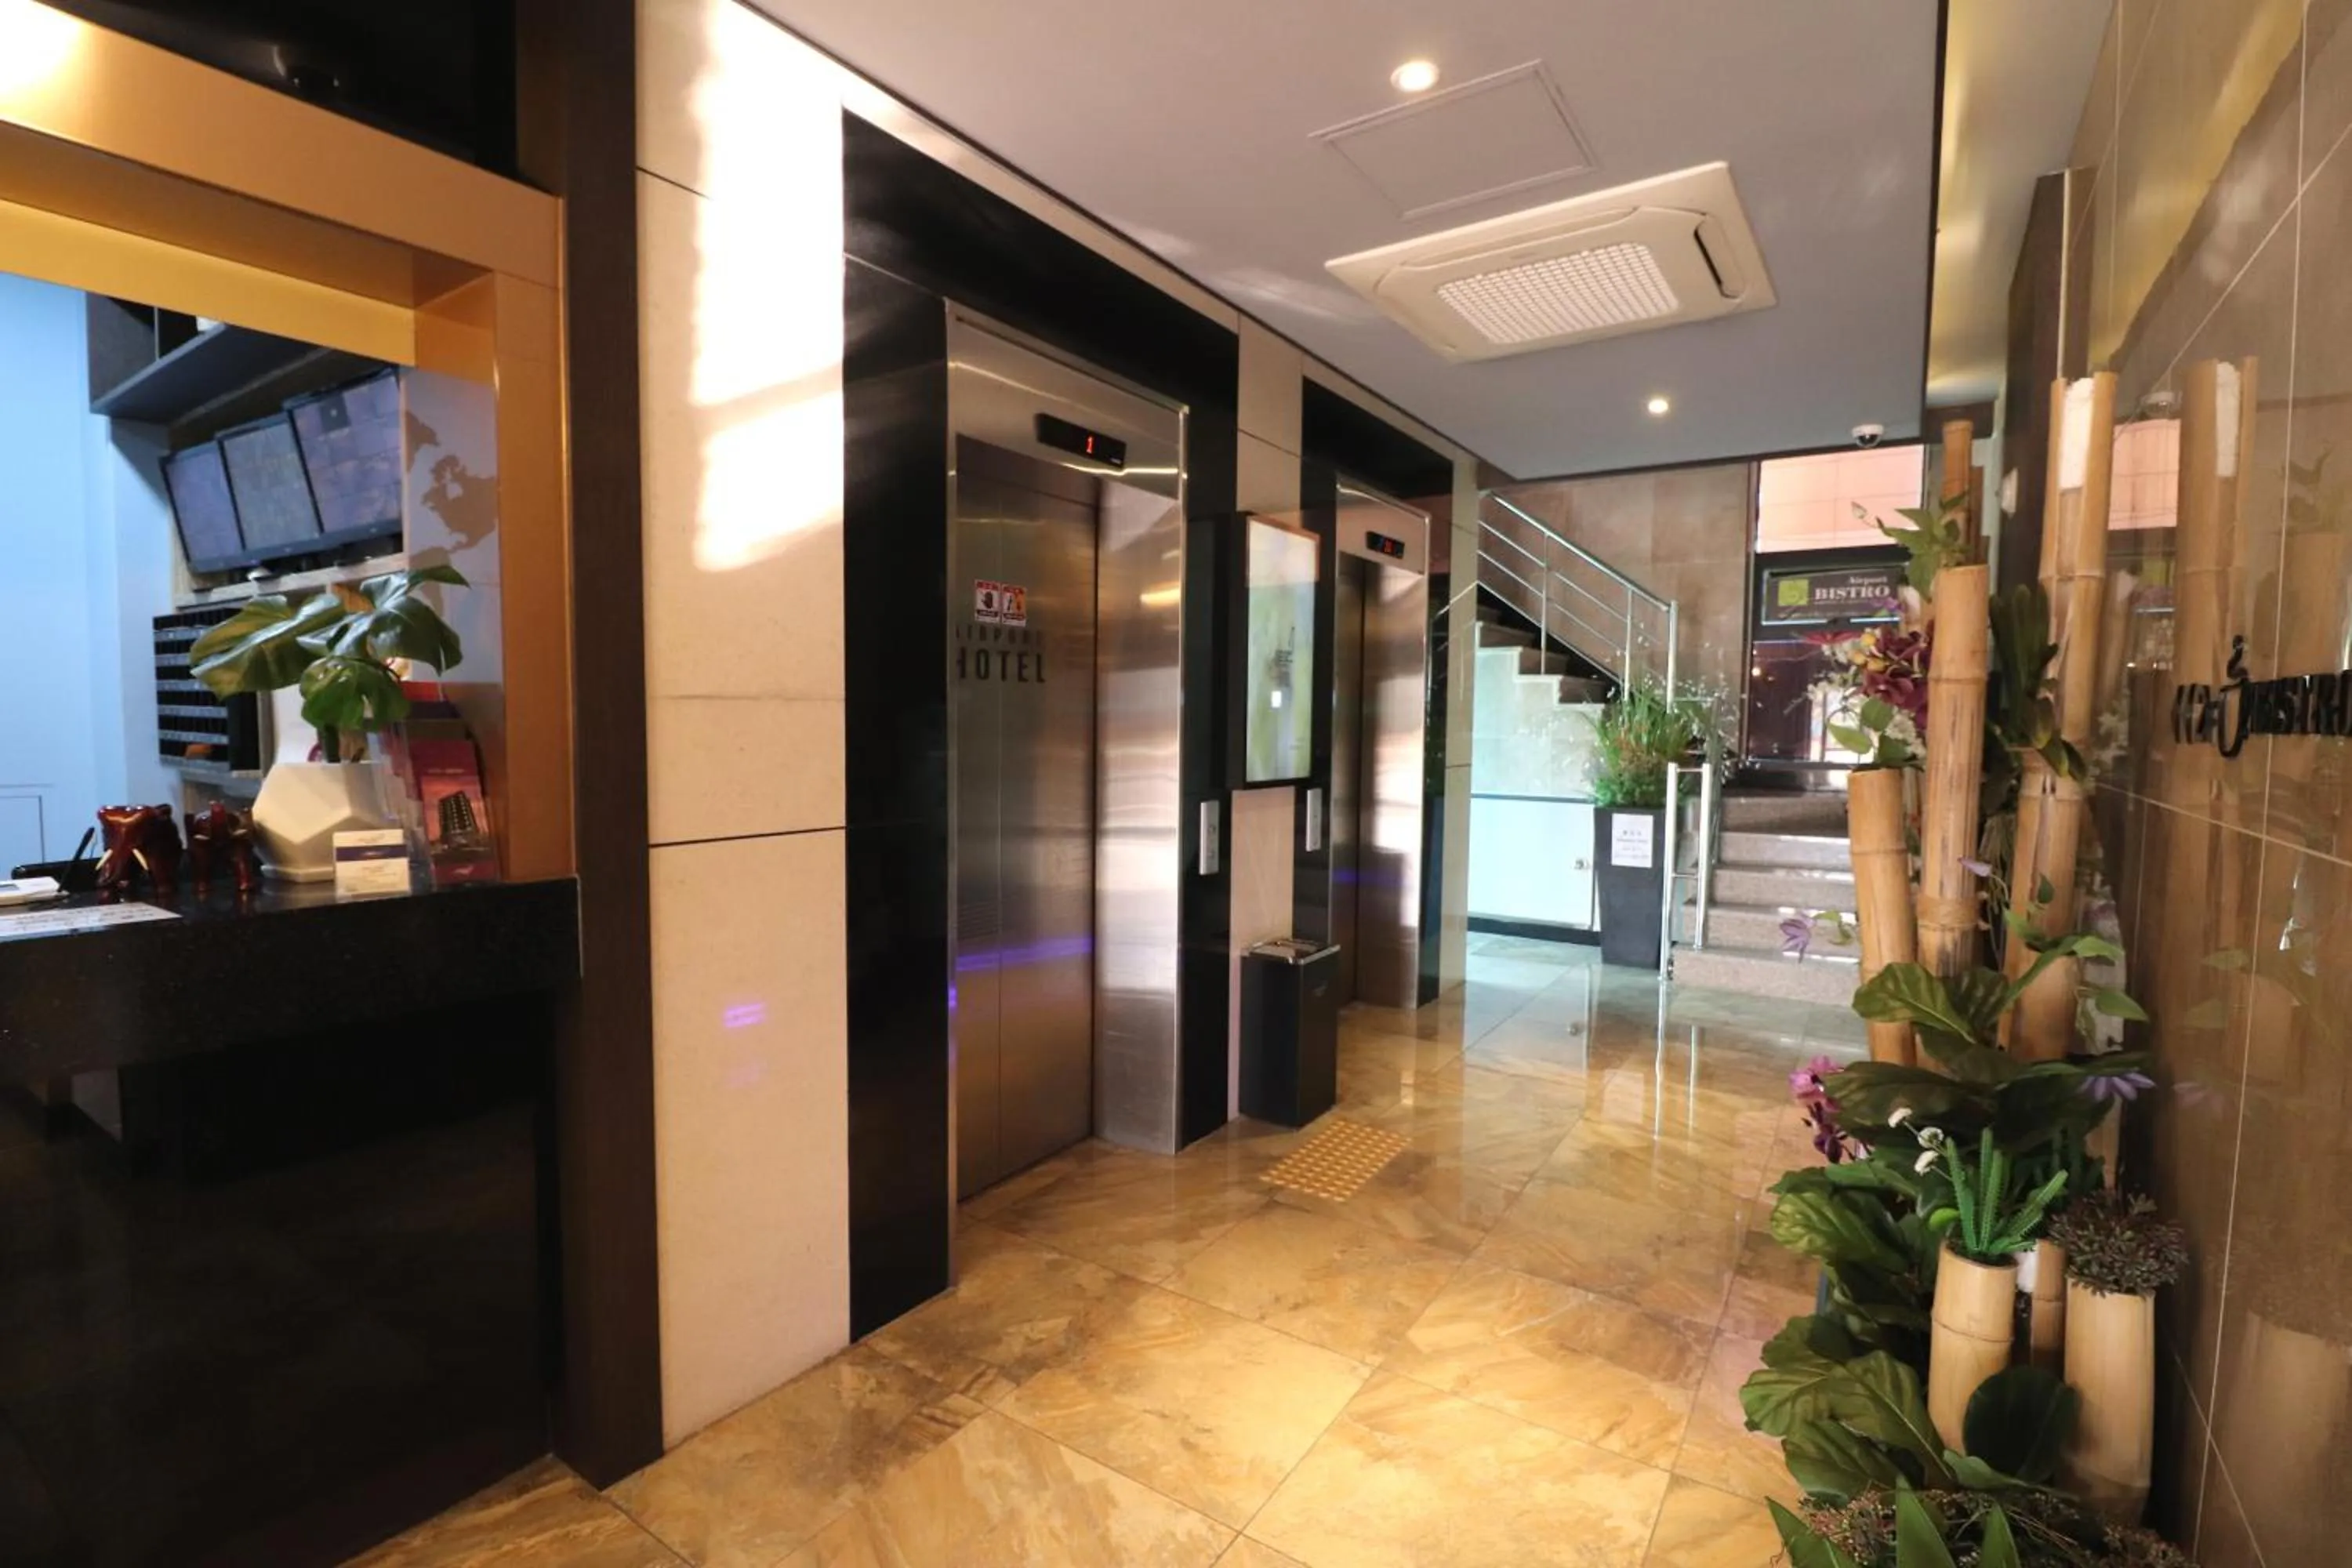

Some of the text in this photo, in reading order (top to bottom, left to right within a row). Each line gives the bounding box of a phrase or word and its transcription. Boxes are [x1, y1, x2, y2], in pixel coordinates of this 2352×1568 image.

[1086, 435, 1094, 454] 1
[1849, 575, 1887, 585] Airport
[1814, 586, 1890, 601] BISTRO
